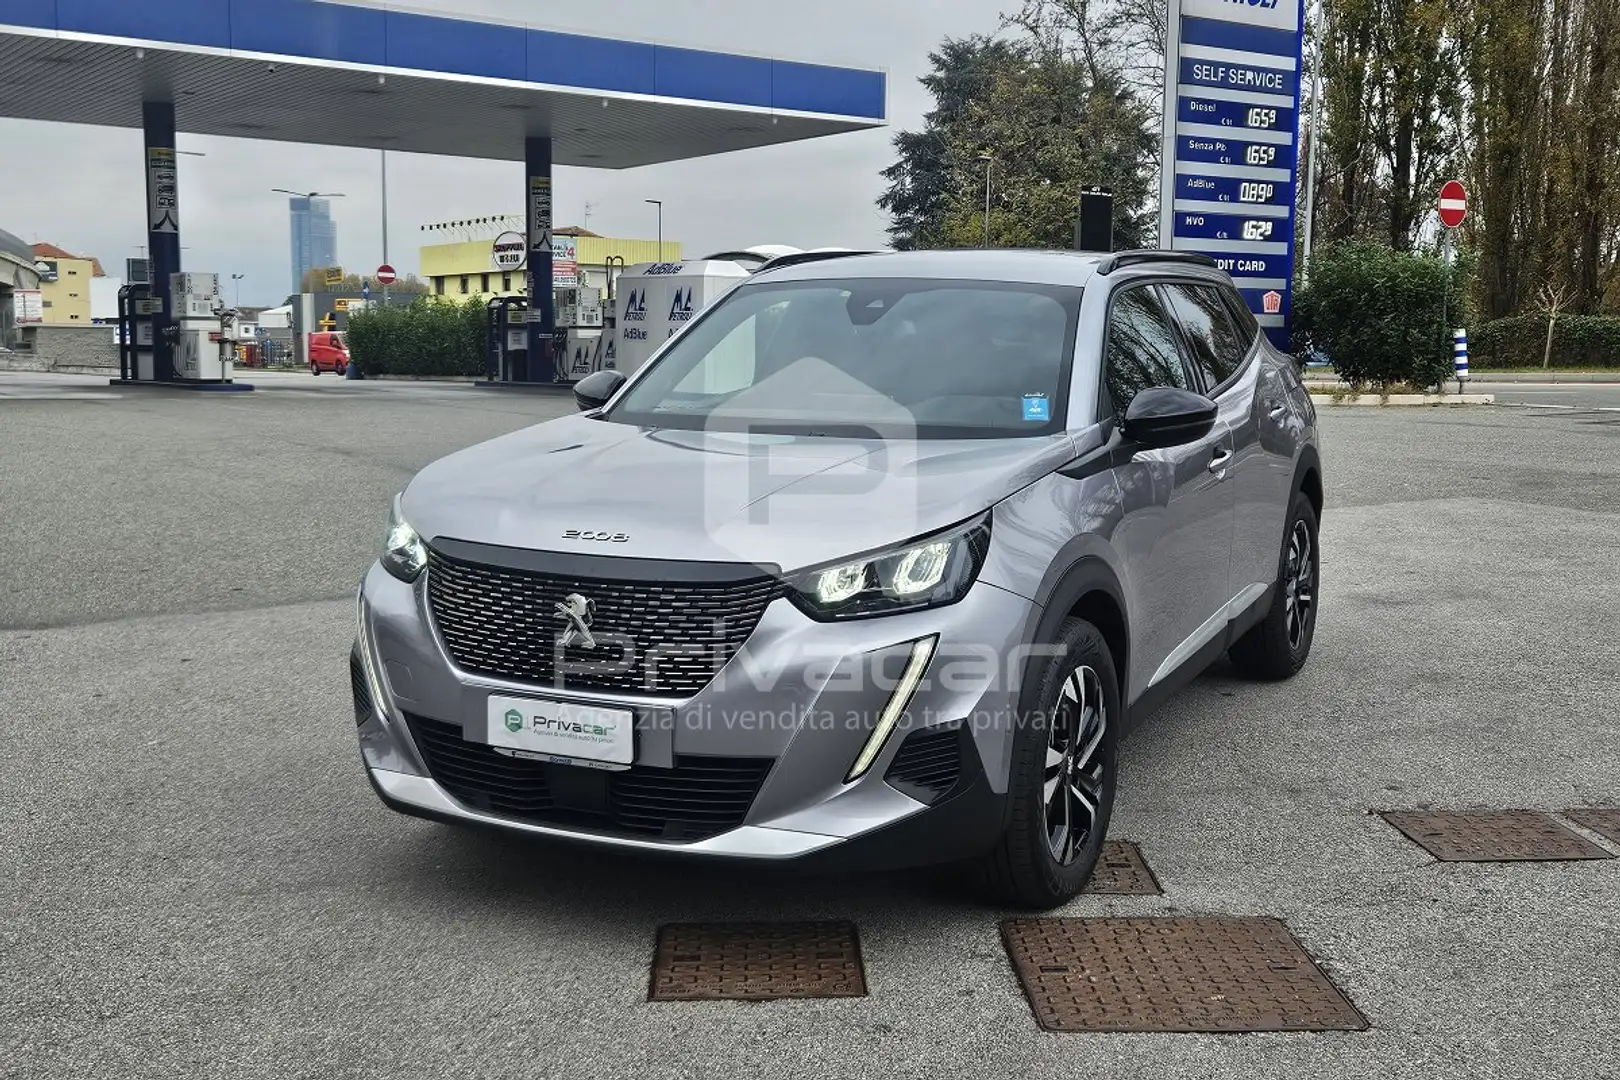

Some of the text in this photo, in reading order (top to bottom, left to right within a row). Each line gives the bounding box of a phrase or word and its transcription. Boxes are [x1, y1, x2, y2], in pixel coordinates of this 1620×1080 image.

[1193, 64, 1283, 89] SELF SERVICE
[1190, 101, 1216, 112] Diesel
[1189, 140, 1227, 151] Senza Pb
[1187, 178, 1215, 189] AdBlue
[1185, 216, 1204, 226] HVO
[643, 263, 684, 275] AdBlue
[1237, 260, 1266, 271] CARD
[624, 328, 648, 340] AdBlue
[561, 530, 631, 543] 2008
[533, 715, 616, 736] Privacar
